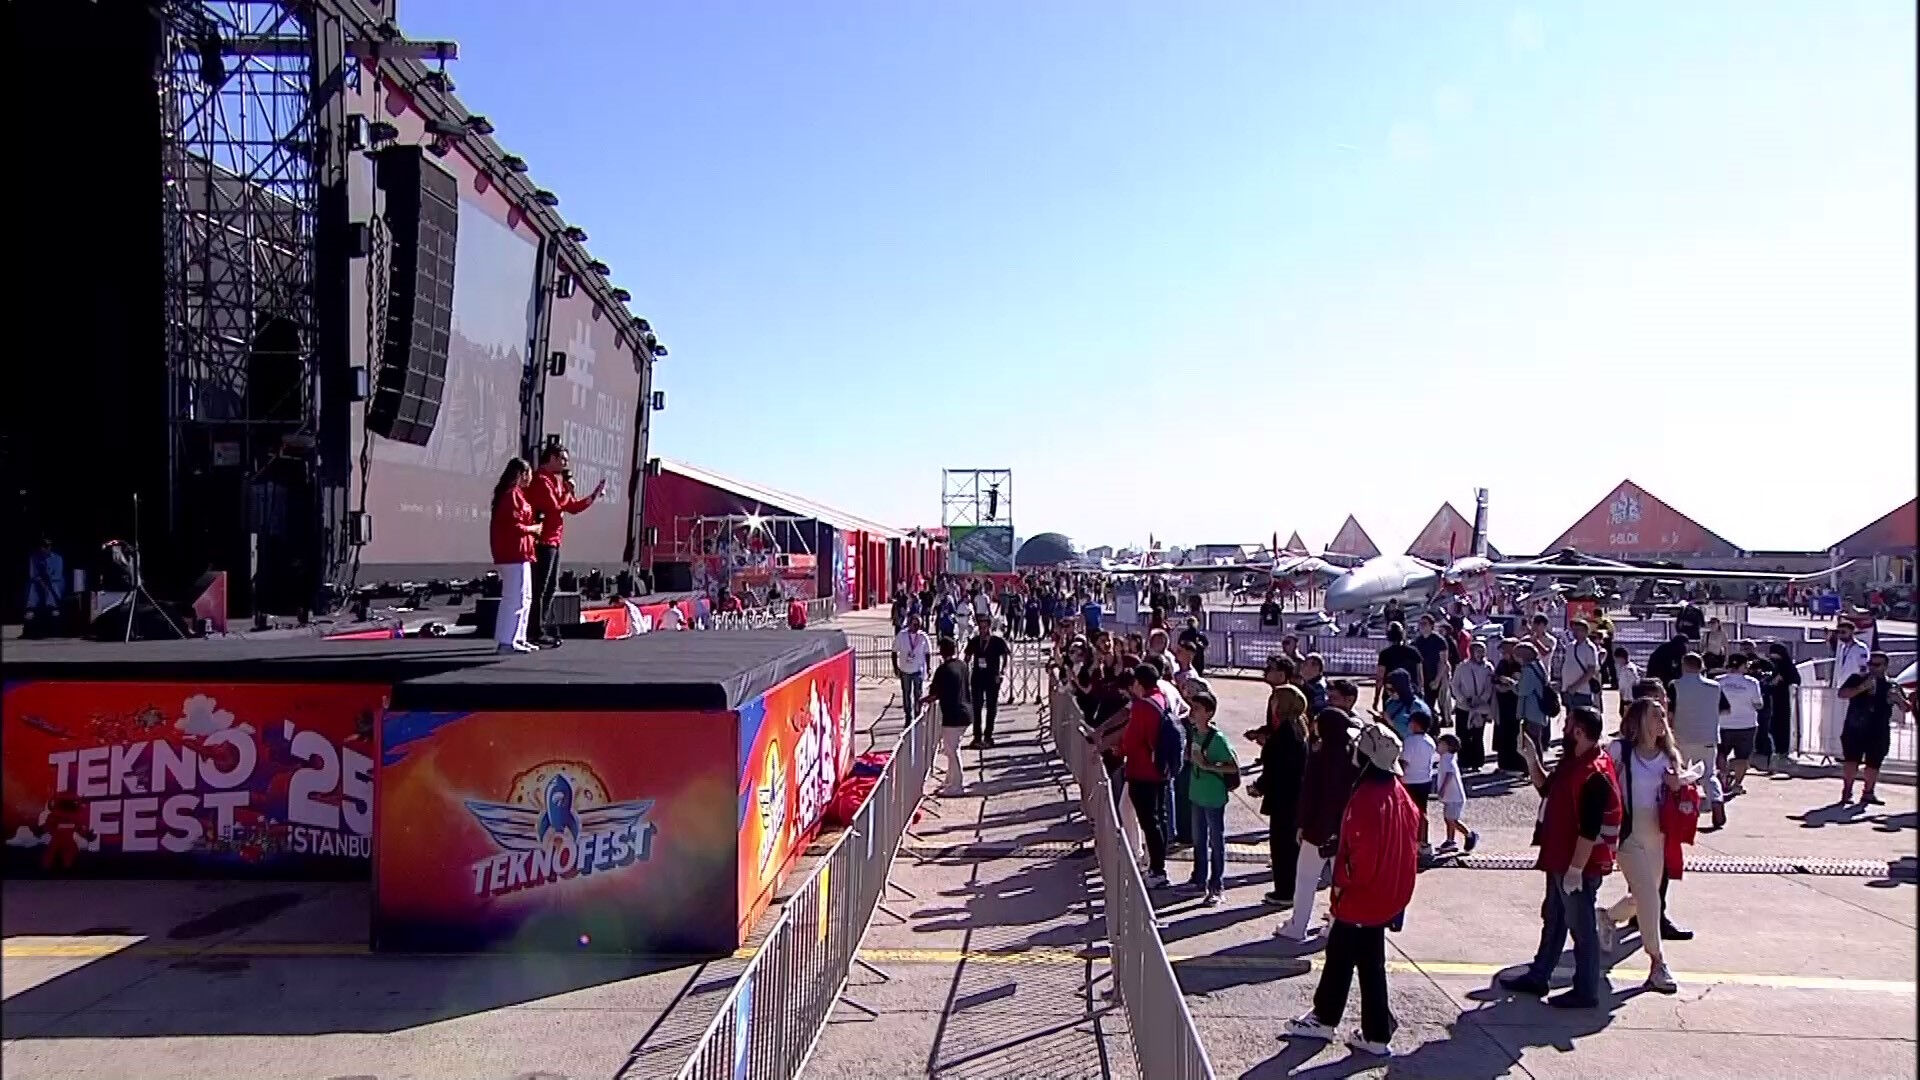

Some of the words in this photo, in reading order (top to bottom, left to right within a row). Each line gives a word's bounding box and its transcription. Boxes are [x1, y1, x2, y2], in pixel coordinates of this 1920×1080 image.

[49, 728, 257, 797] TEKNO
[88, 791, 249, 853] FEST
[473, 820, 654, 896] TEKNOFEST
